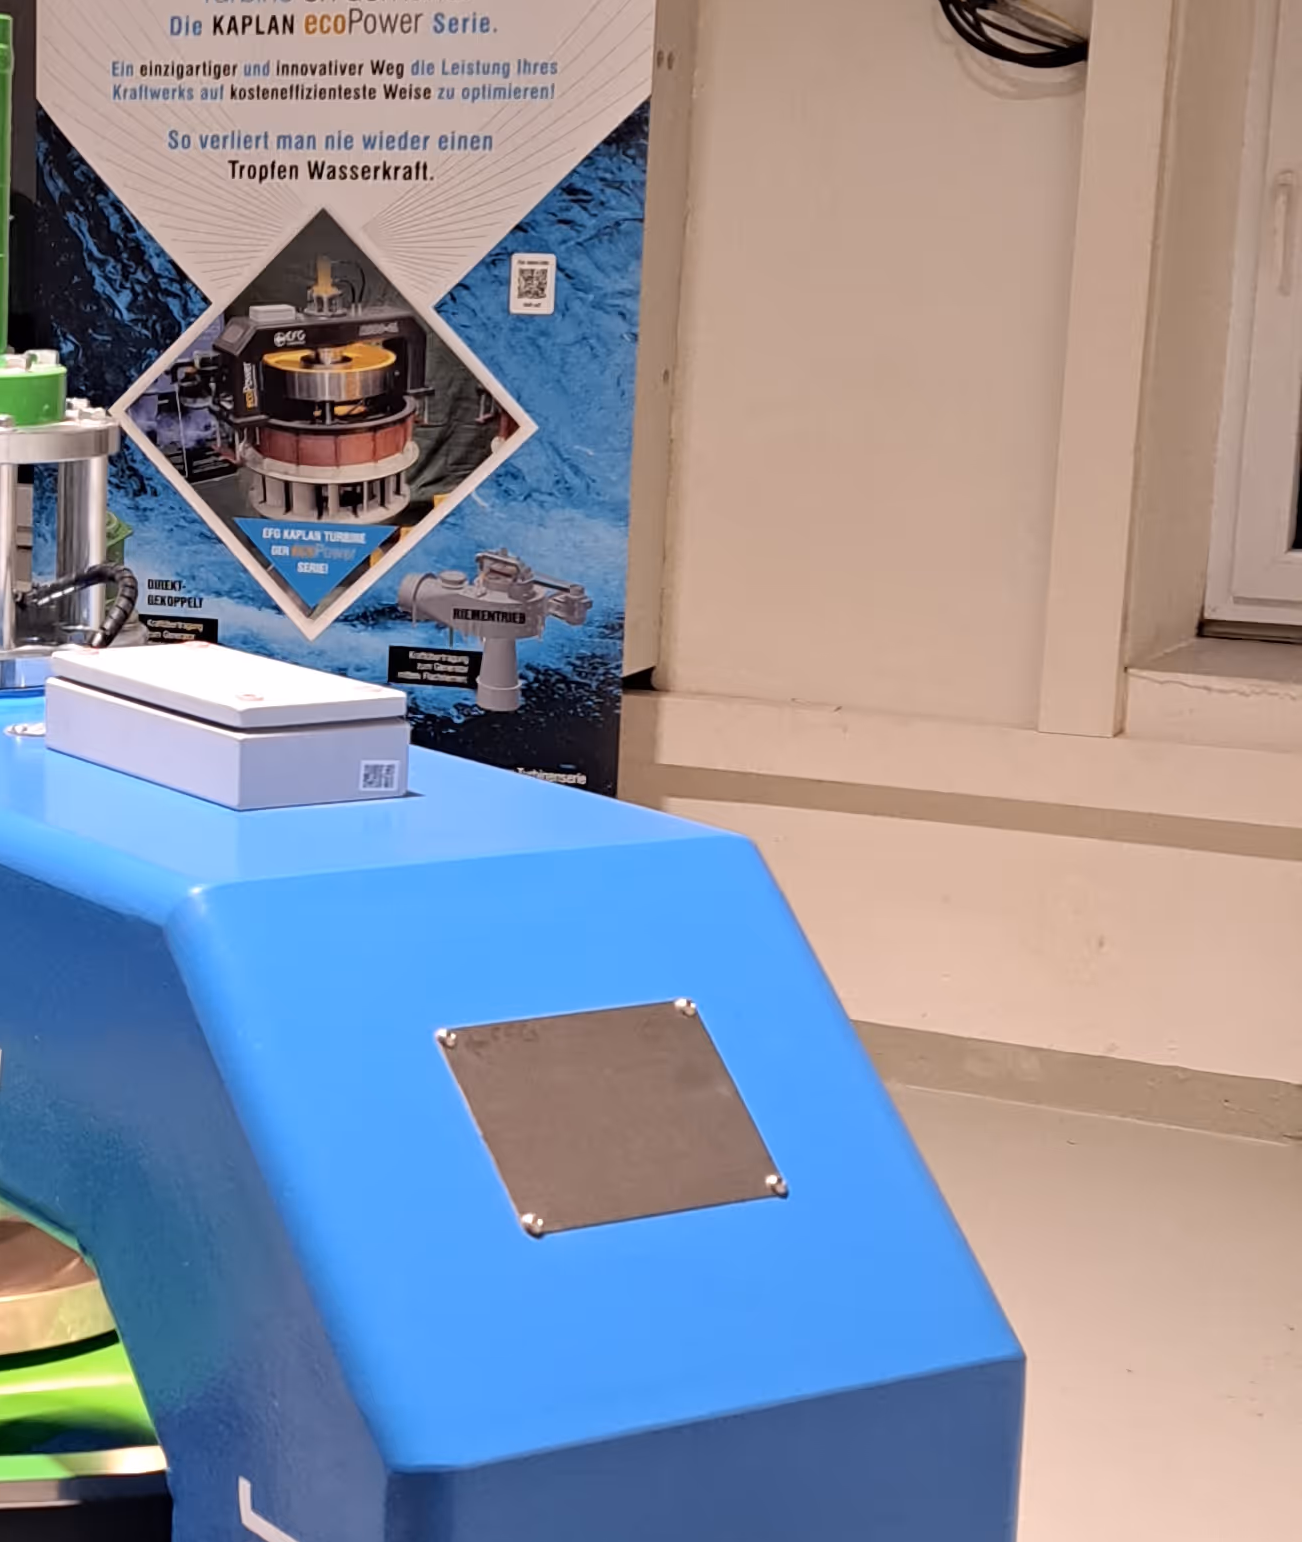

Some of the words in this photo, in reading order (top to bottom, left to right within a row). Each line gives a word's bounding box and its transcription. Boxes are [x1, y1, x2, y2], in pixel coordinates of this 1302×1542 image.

[169, 15, 202, 36] Die
[212, 14, 295, 35] KAPLAN
[304, 7, 423, 35] ecoPower
[432, 12, 498, 34] Serie.
[111, 61, 134, 77] Ein
[140, 60, 238, 80] einzigartiger
[243, 60, 270, 77] und
[276, 60, 364, 77] innovativer
[370, 59, 404, 79] Weg
[410, 59, 435, 76] die
[441, 59, 510, 79] Leistung
[517, 58, 558, 76] Ihres
[112, 84, 194, 101] Kraftwerks
[200, 84, 224, 101] auf
[230, 83, 377, 101] kosteneffizienteste
[383, 83, 432, 100] Weise
[437, 86, 455, 100] zu
[461, 82, 555, 103] optimieren!
[168, 129, 191, 150] So
[199, 129, 269, 150] verliert
[276, 134, 317, 151] man
[324, 130, 354, 151] nie
[362, 130, 431, 151] wieder
[438, 130, 493, 151] einen
[228, 159, 299, 184] Tropfen
[307, 160, 435, 181] Wasserkraft.
[147, 595, 203, 608] GEKOPPELT
[453, 608, 526, 624] RIEMENTRIEB
